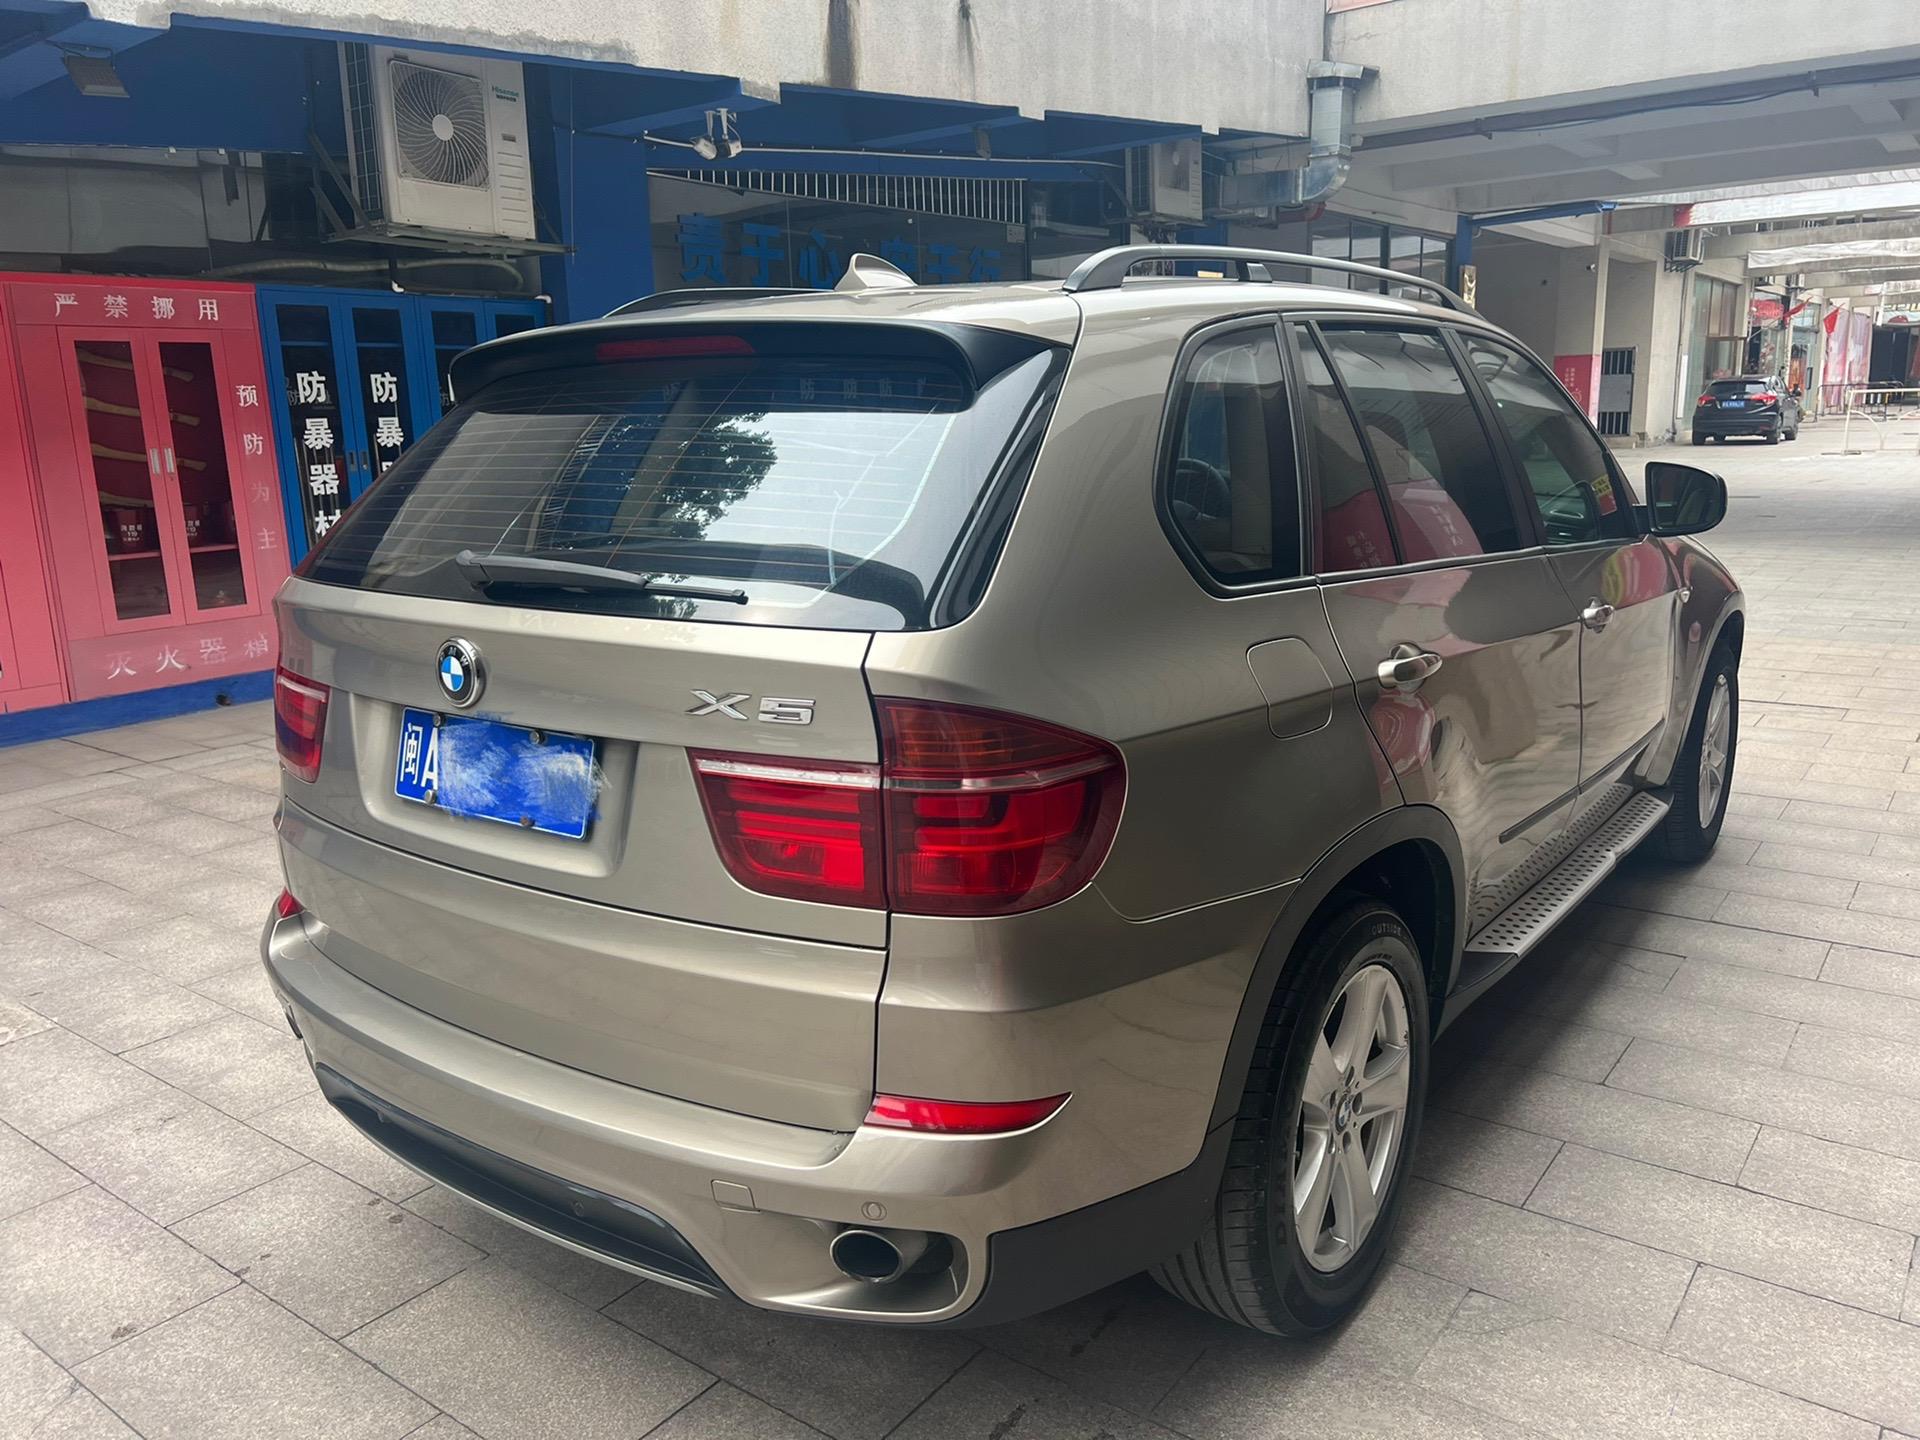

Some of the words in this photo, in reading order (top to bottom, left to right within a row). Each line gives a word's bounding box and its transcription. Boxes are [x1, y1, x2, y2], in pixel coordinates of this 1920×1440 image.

[54, 293, 219, 321] 严禁挪用
[236, 384, 278, 550] 预防为主
[296, 370, 342, 537] 防暴器材
[107, 634, 269, 680] 灭火器箱
[440, 646, 469, 667] BMW
[684, 689, 816, 725] X5
